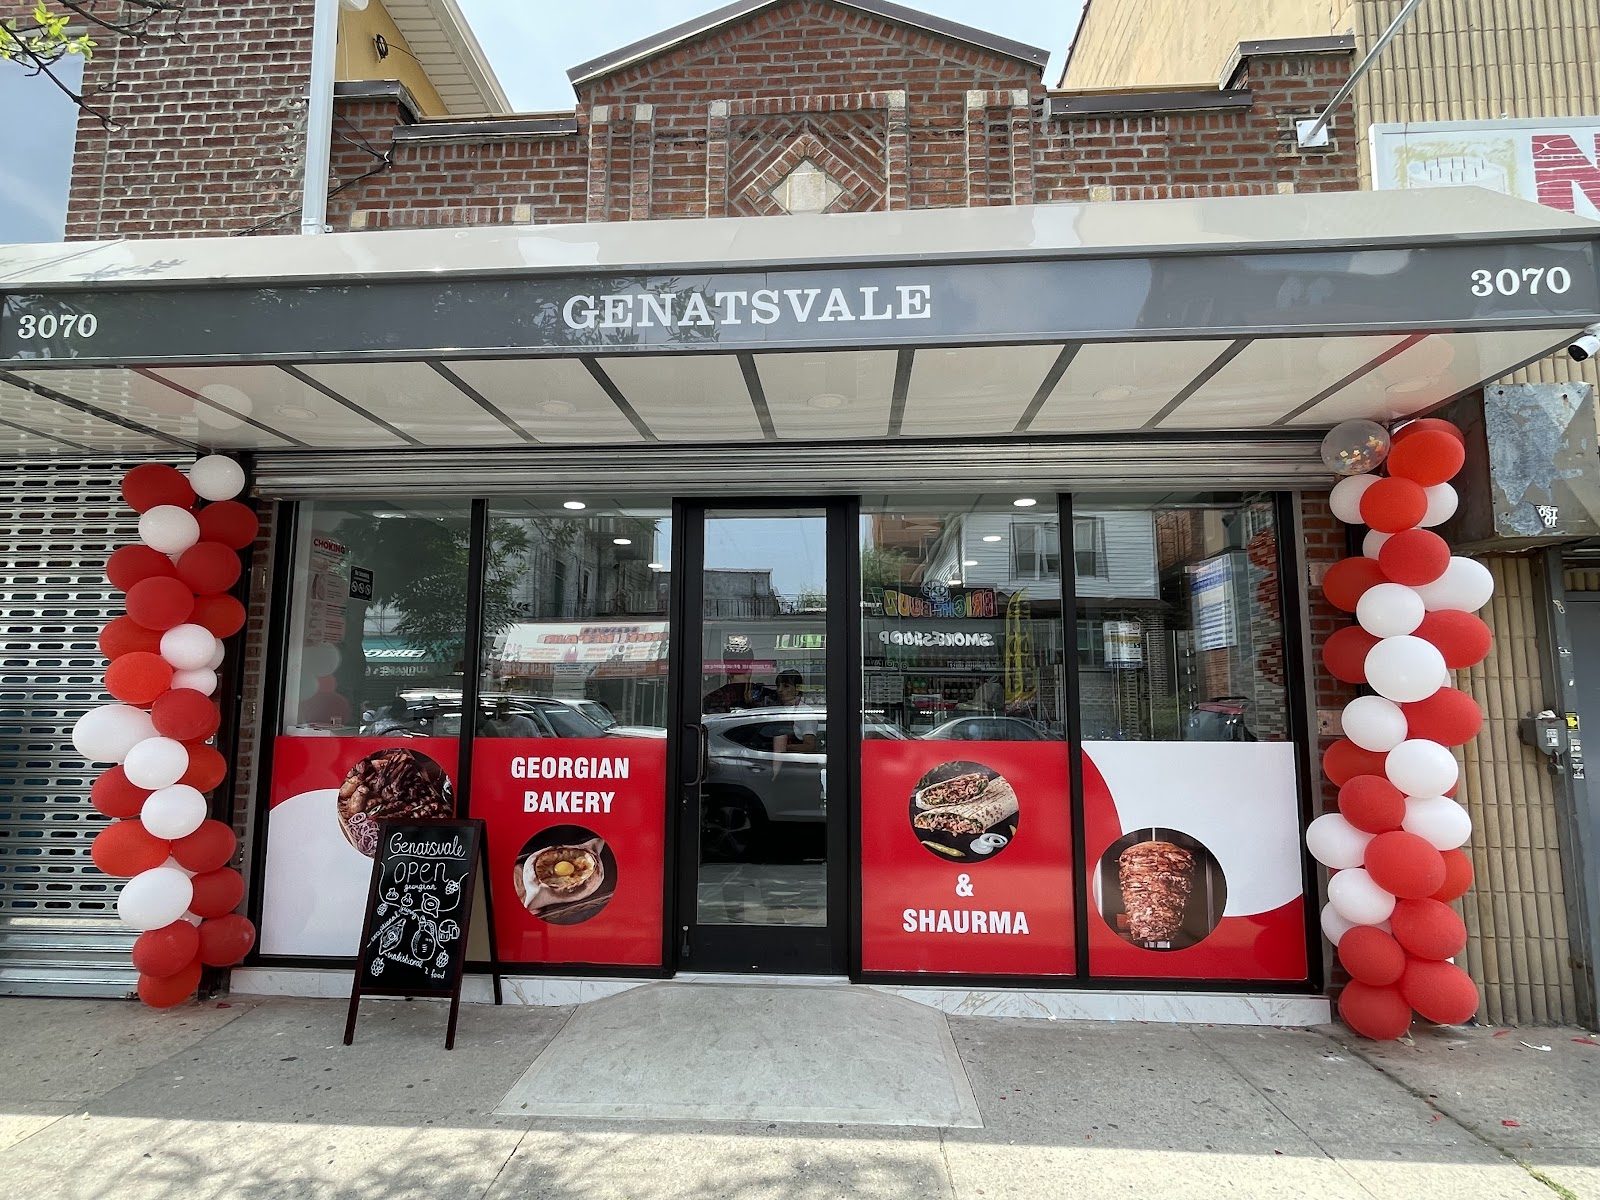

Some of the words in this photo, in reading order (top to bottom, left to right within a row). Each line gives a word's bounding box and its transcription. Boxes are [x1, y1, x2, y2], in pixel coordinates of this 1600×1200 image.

[1470, 266, 1571, 297] 3070
[562, 284, 932, 330] GENATSVALE
[17, 313, 98, 339] 3070
[313, 538, 346, 554] CHOKING
[511, 756, 630, 779] GEORGIAN
[523, 790, 616, 814] BAKERY
[389, 832, 466, 858] Genatsvale
[955, 873, 974, 897] &
[902, 908, 1030, 935] SHAURMA
